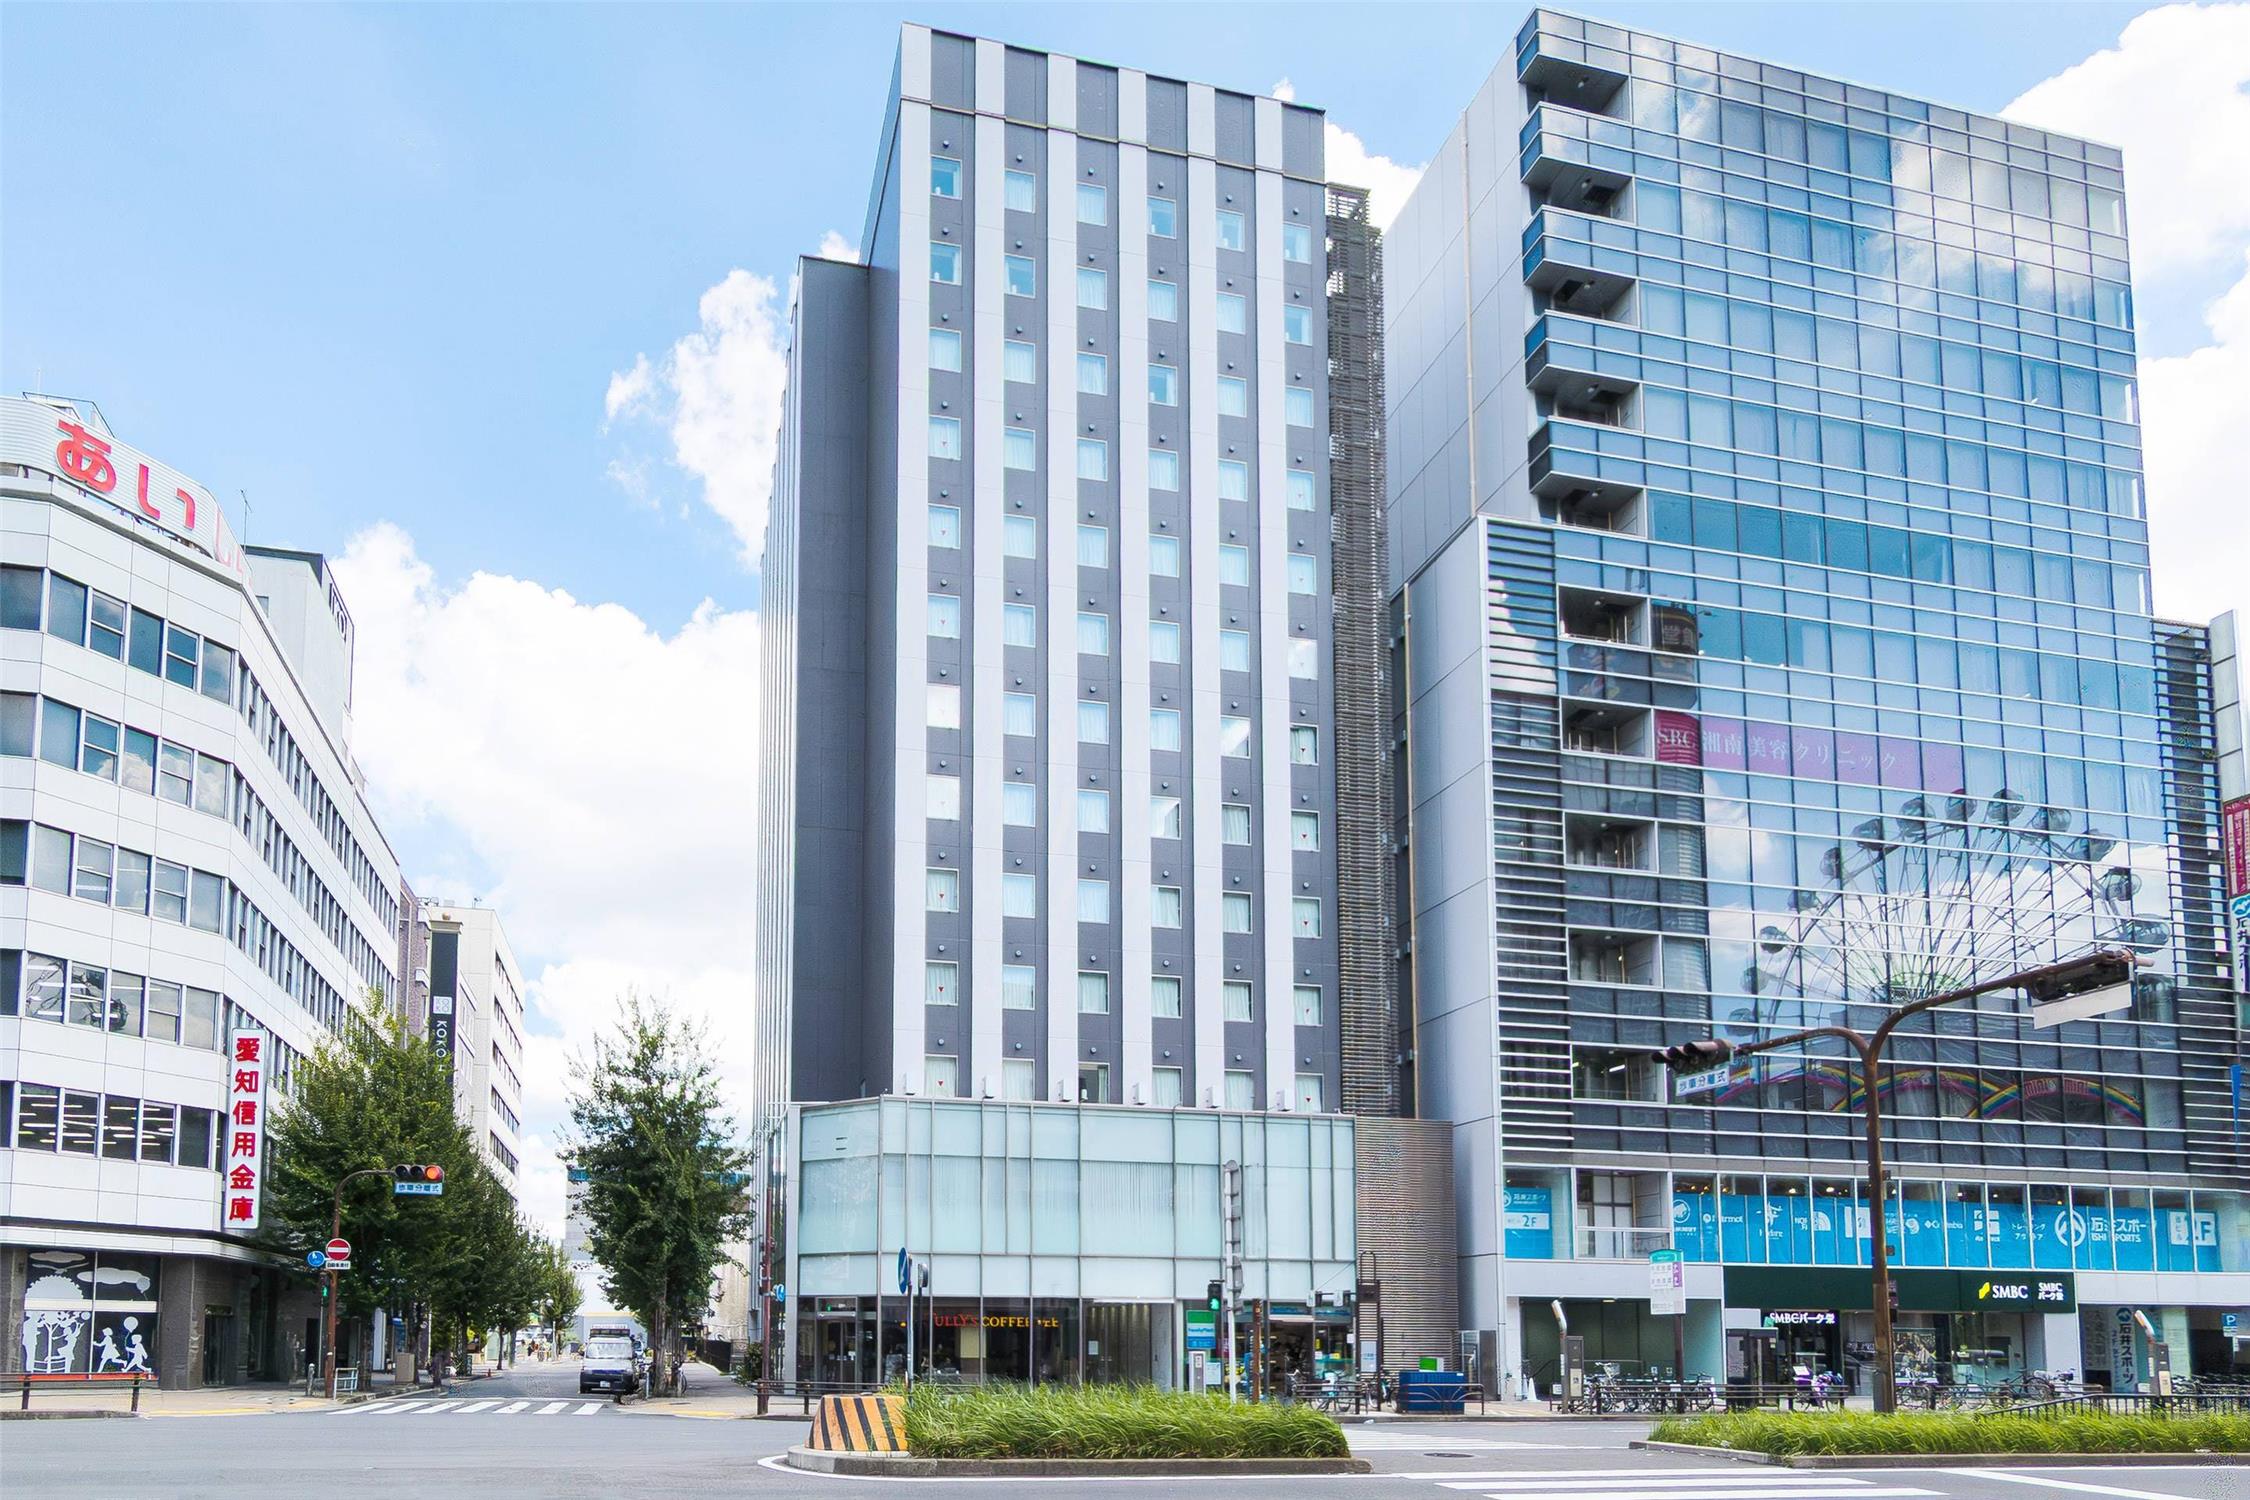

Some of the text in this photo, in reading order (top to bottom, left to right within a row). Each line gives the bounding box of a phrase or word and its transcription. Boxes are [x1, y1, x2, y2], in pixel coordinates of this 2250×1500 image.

[56, 419, 196, 530] あい
[1656, 727, 1896, 769] SBC 湘南美容クリニック
[436, 1020, 448, 1058] KOKO
[229, 1037, 260, 1222] 愛知信用金庫
[1522, 1214, 1537, 1227] 2F
[2011, 1222, 2046, 1232] トレーング
[1992, 1285, 2028, 1299] SMBC
[2038, 1282, 2063, 1292] SMBC
[1769, 1312, 1836, 1324] SMBCパーク栄
[2118, 1323, 2135, 1384] 石井スポーツ
